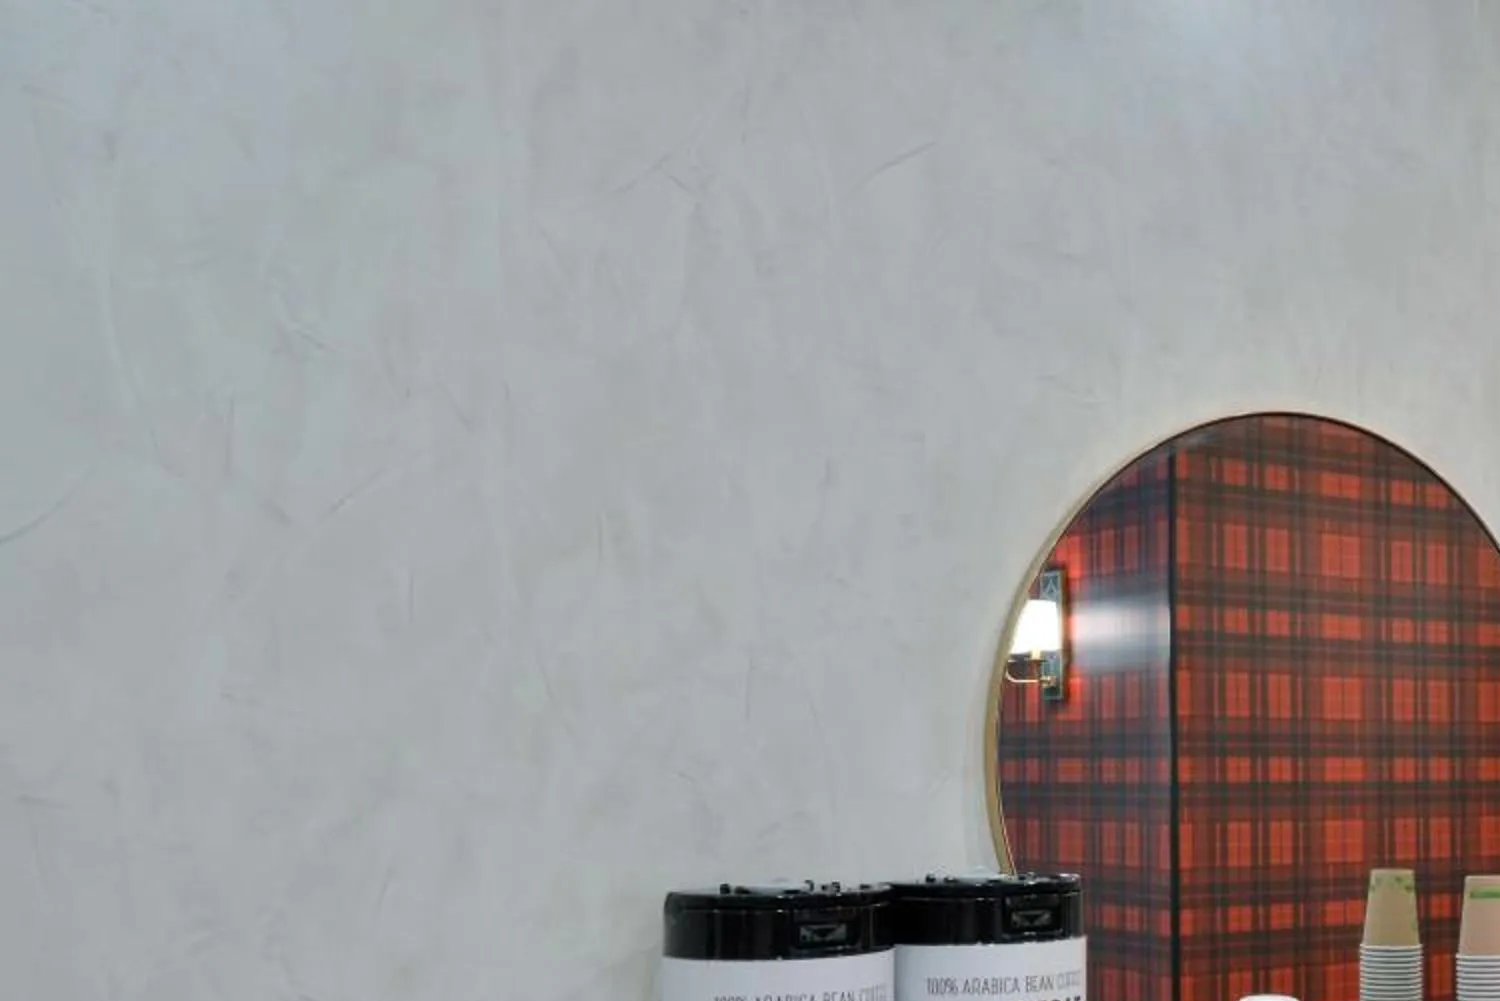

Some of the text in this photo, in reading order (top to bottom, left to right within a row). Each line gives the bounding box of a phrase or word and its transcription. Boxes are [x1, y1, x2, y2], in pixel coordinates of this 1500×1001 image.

[926, 977, 958, 996] 100%
[963, 975, 1020, 996] ARABICA
[1025, 975, 1054, 993] BEAN
